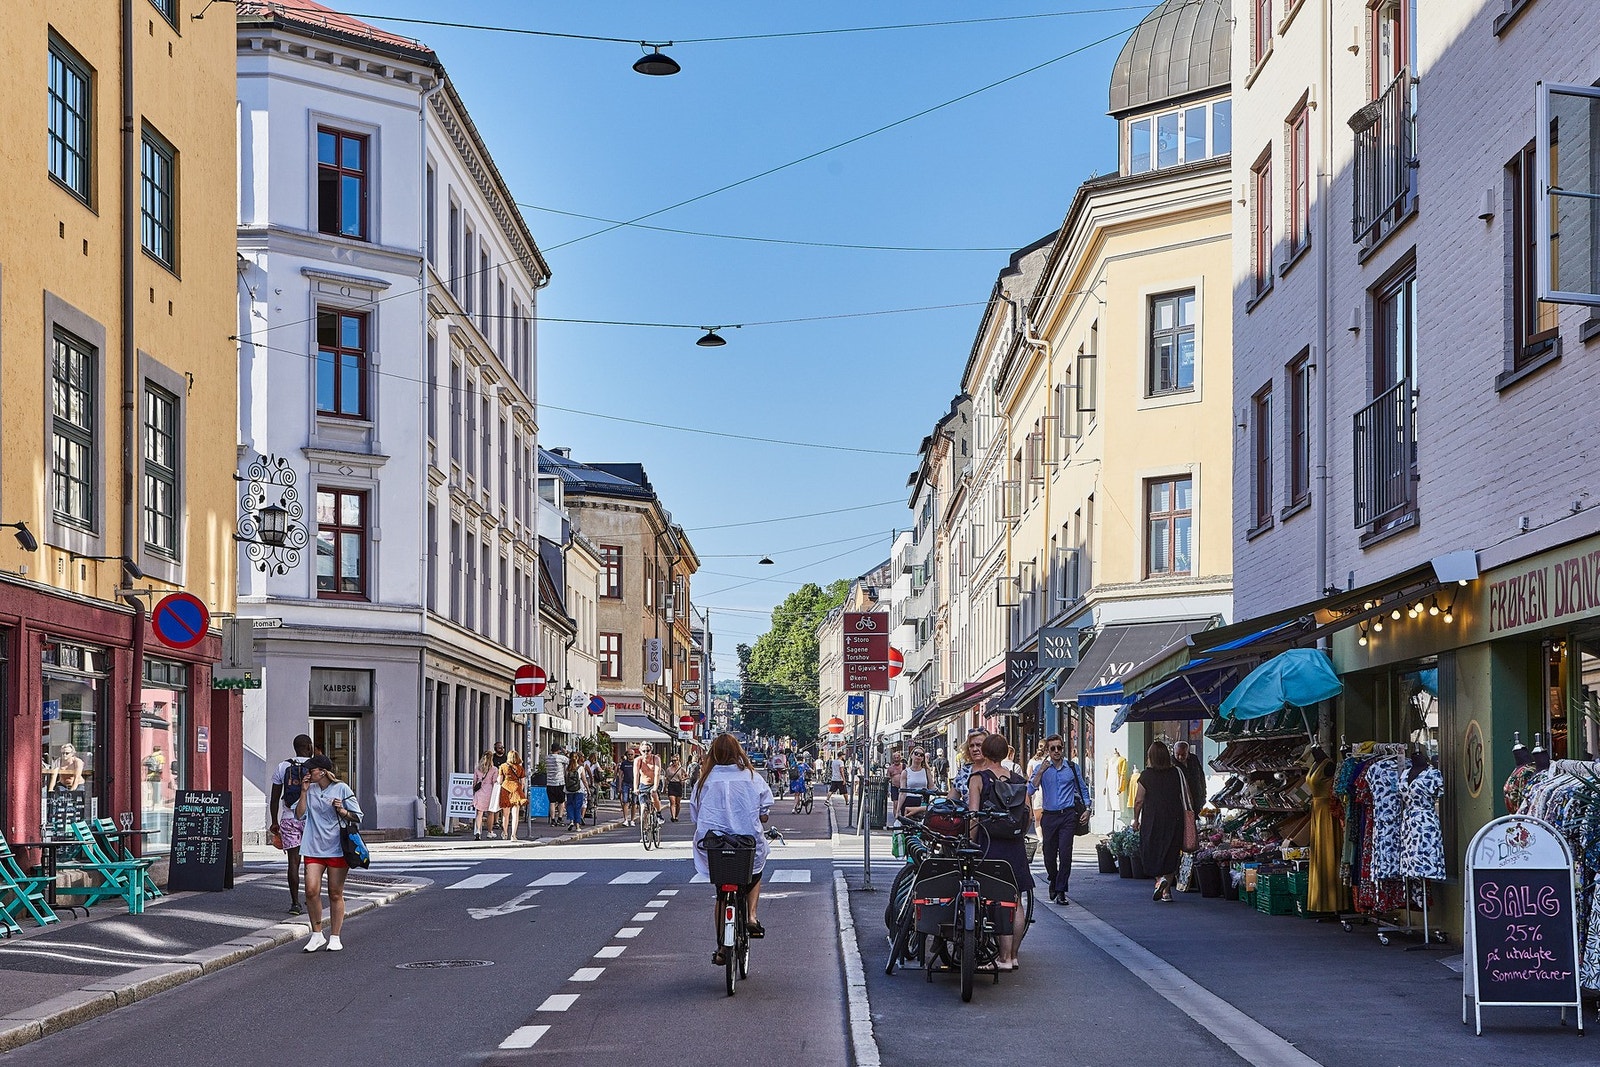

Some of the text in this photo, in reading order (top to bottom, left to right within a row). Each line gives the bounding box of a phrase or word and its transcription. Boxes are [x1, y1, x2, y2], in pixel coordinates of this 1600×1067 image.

[1490, 567, 1548, 633] FRØKEN
[1044, 636, 1072, 648] NOA
[649, 641, 659, 673] SKO
[1044, 648, 1073, 659] NOA
[1011, 669, 1027, 679] NO
[1102, 661, 1135, 676] NO
[323, 684, 357, 693] KAIBOSH
[185, 793, 220, 804] fritz-kola
[206, 806, 225, 814] HOURS
[1477, 881, 1560, 920] SALG
[1504, 924, 1543, 942] 25%
[1485, 946, 1557, 970] på utvalgte
